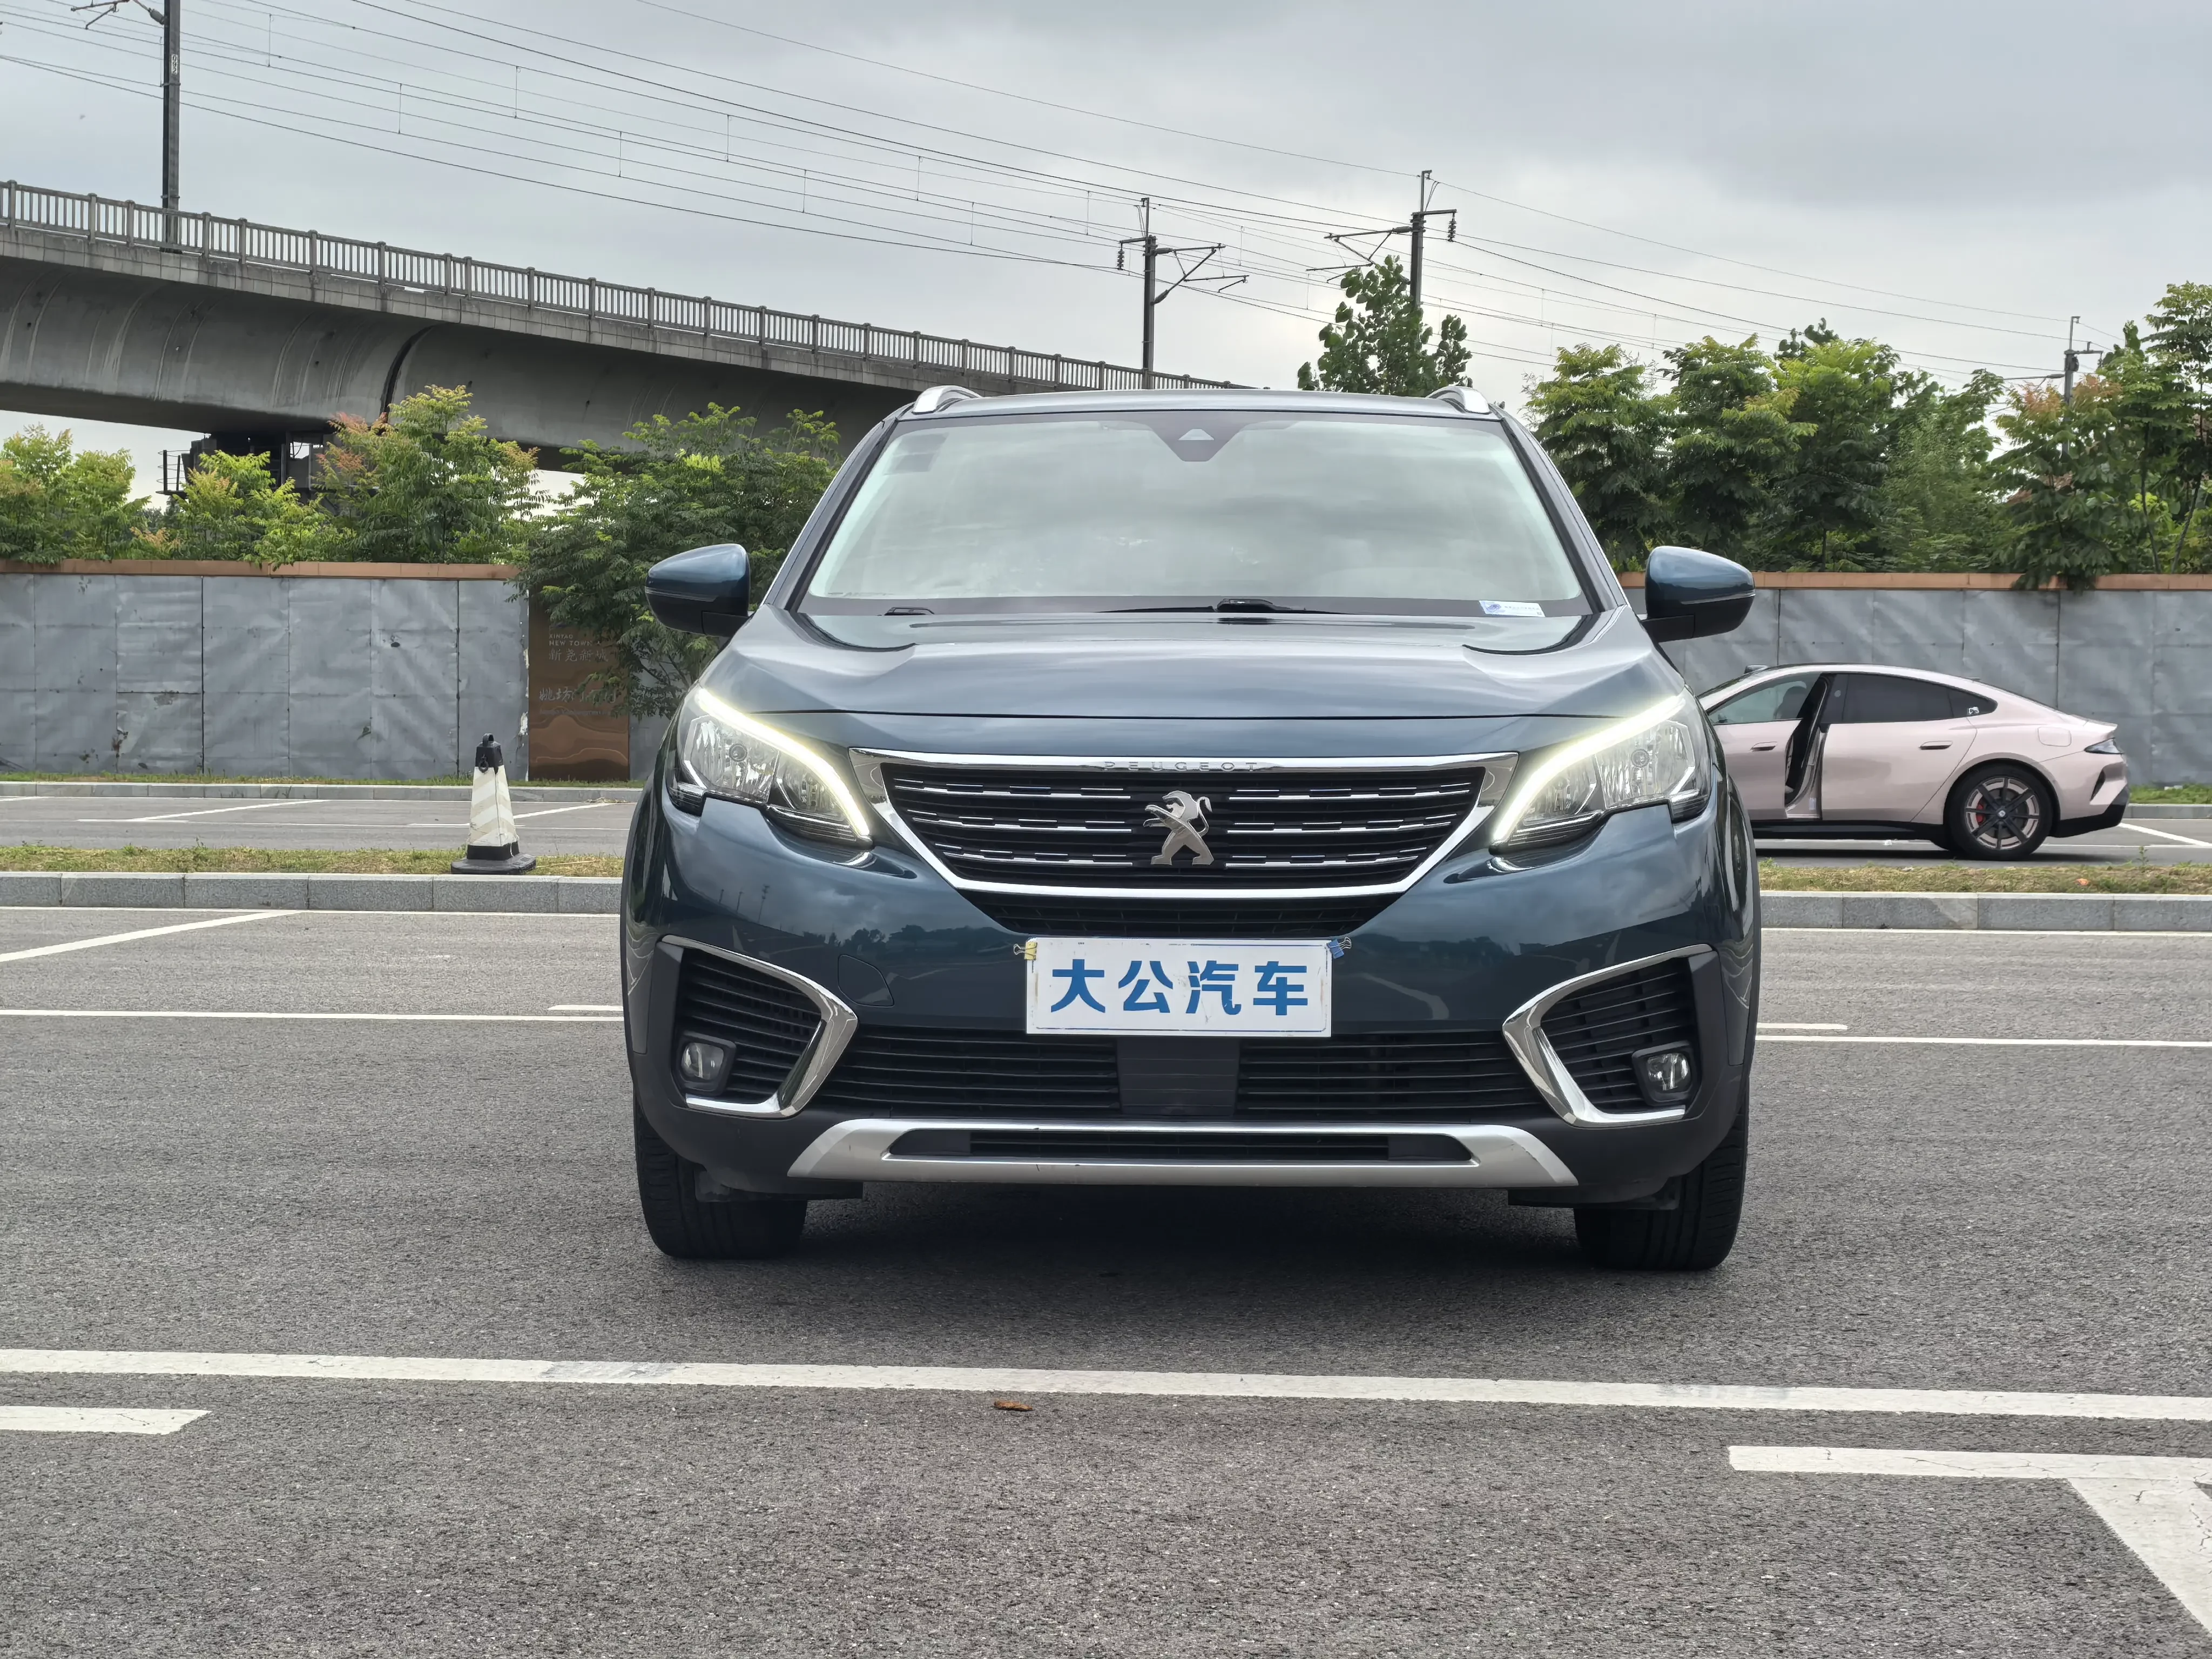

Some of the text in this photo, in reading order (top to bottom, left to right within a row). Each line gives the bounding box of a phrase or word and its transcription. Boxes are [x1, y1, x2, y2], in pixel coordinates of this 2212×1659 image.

[1104, 761, 1257, 771] PEUGEOT
[1051, 959, 1308, 1015] 大公汽车
